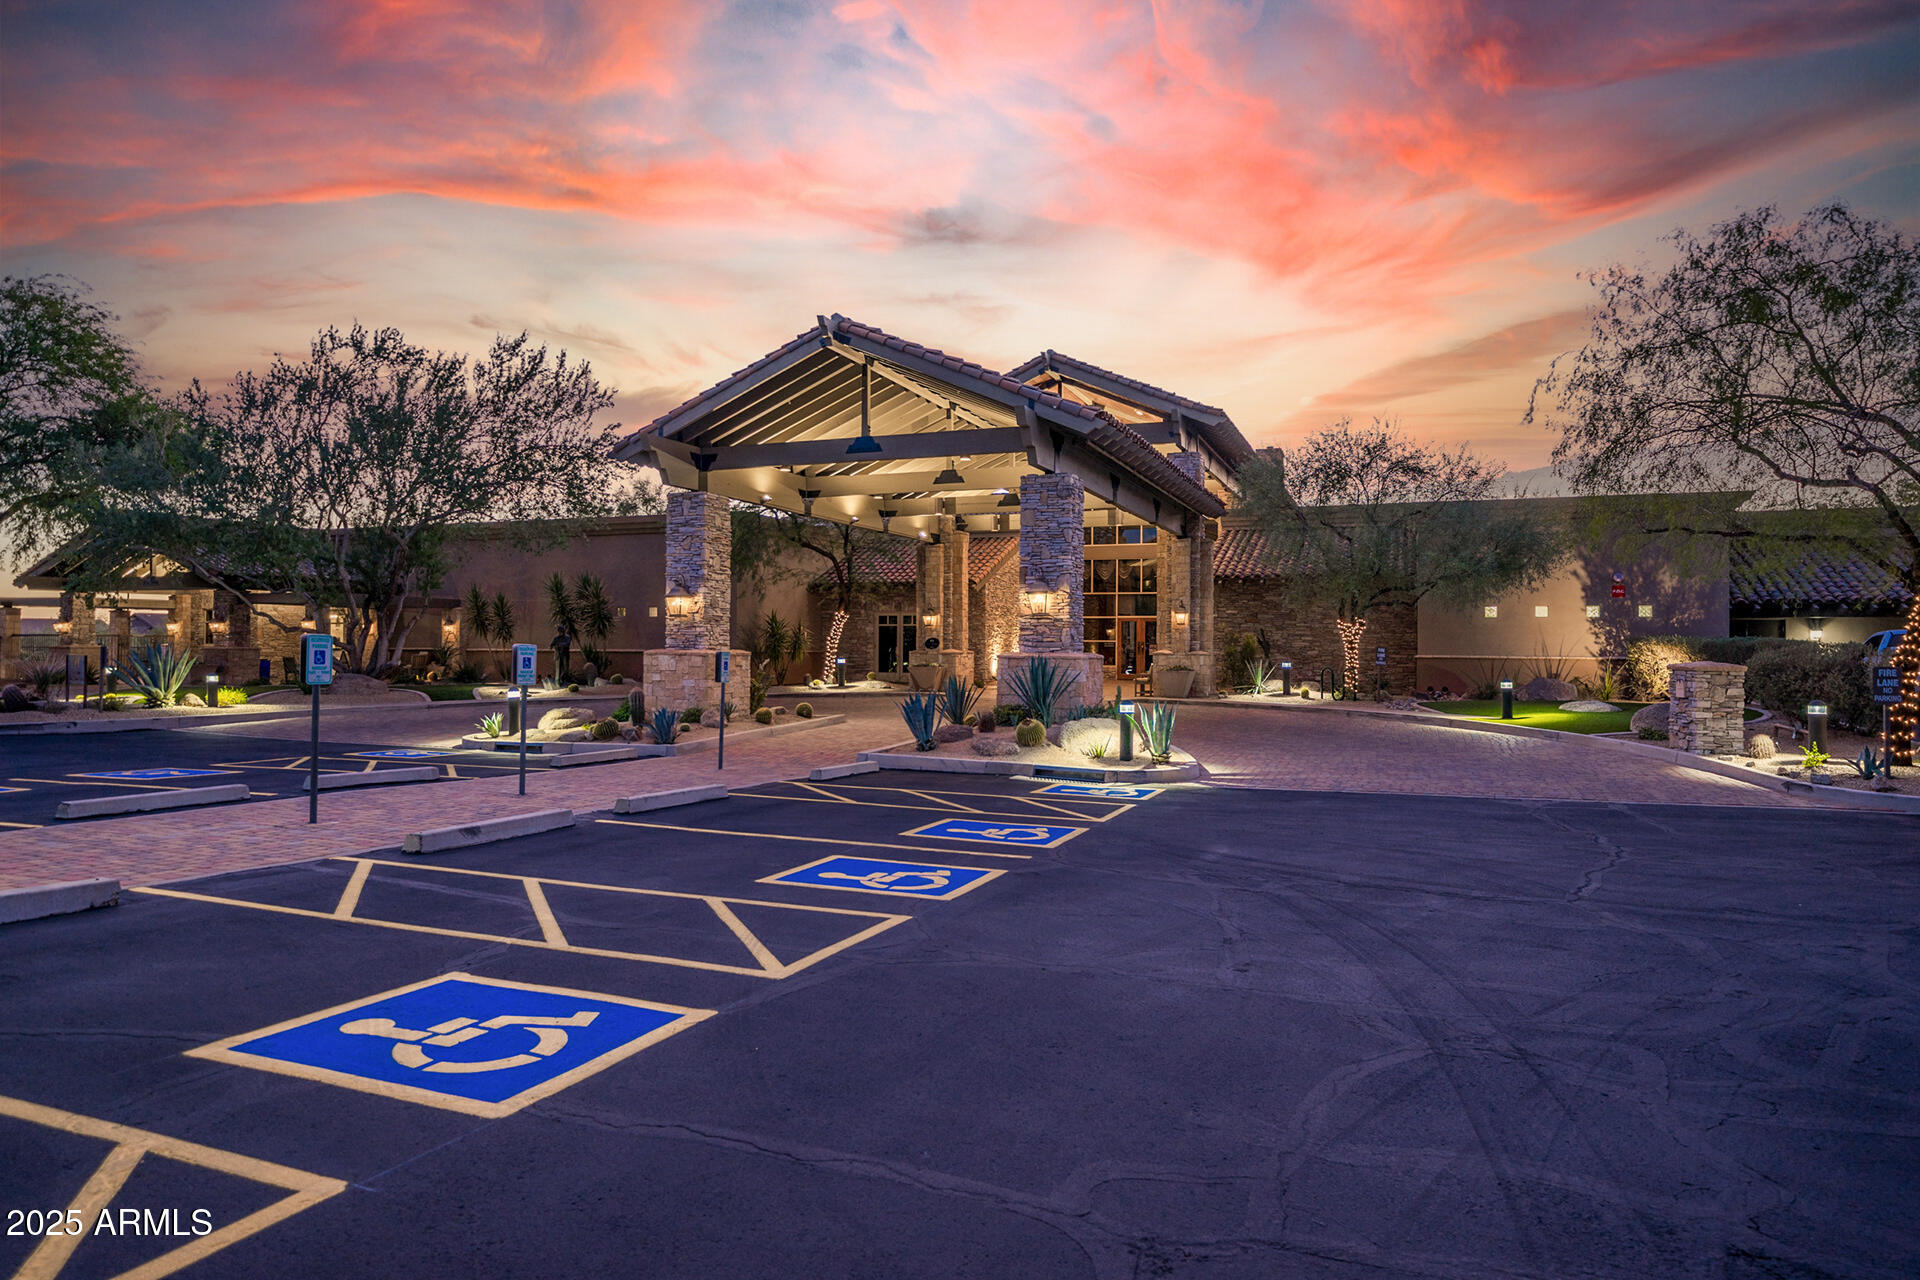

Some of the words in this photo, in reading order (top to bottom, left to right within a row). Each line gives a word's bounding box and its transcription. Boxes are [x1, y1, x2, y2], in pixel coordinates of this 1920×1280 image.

[1878, 668, 1897, 677] FIRE
[1877, 679, 1899, 687] LANE
[1873, 695, 1902, 703] PARKING
